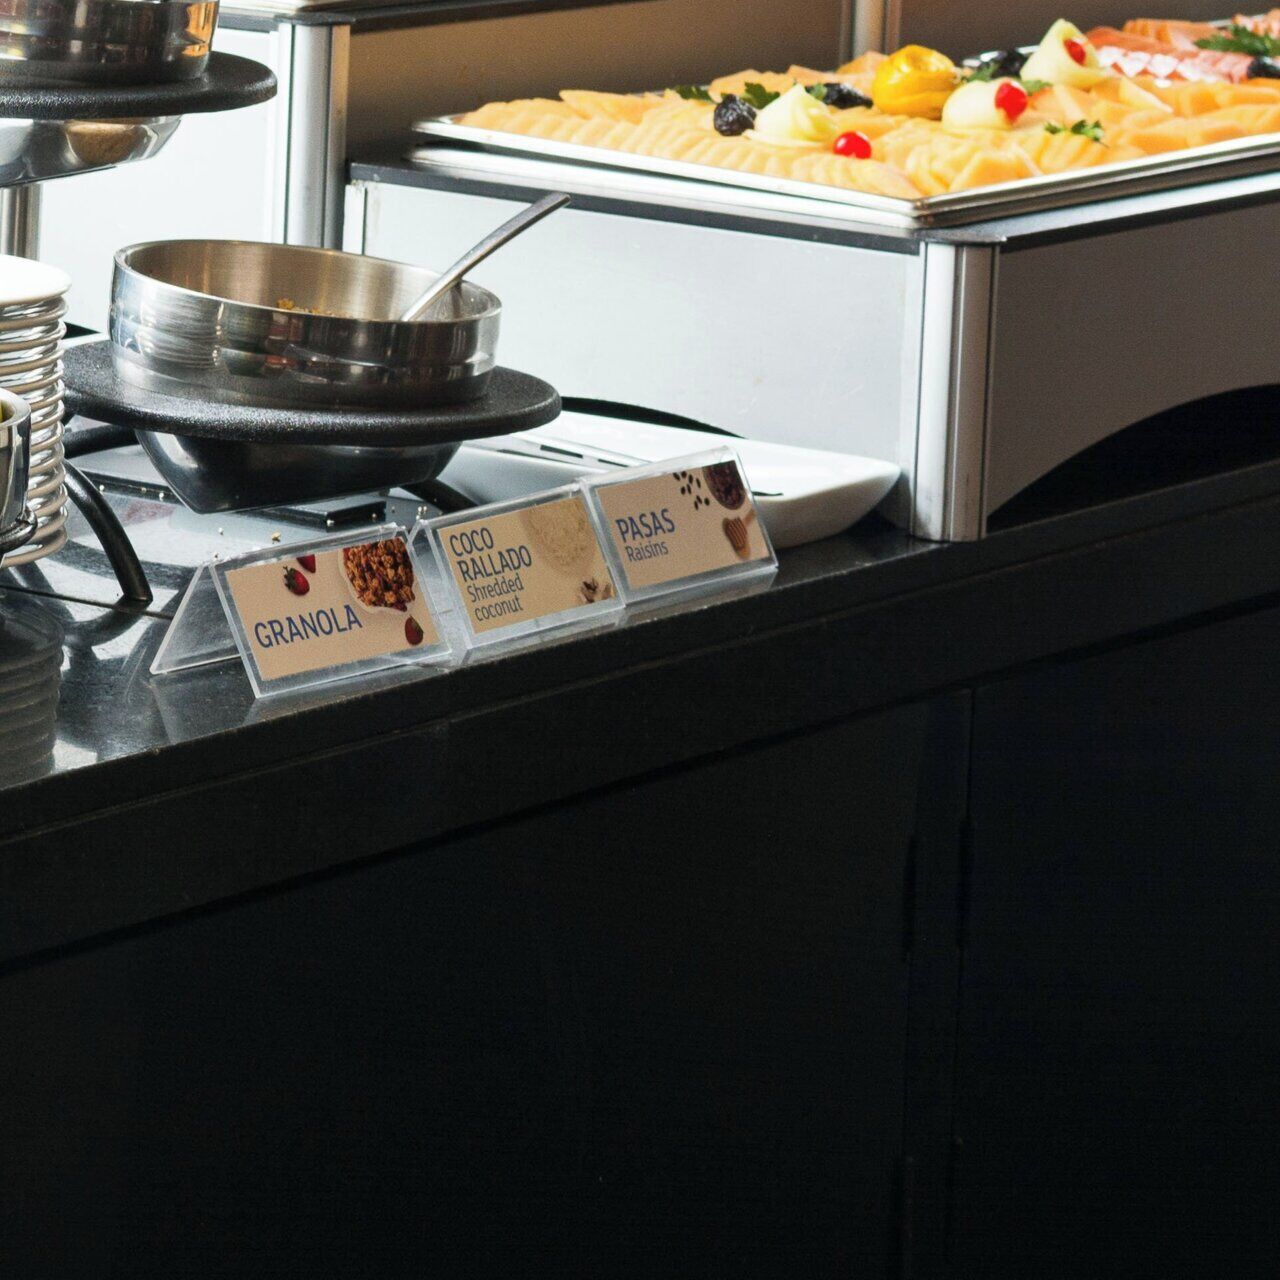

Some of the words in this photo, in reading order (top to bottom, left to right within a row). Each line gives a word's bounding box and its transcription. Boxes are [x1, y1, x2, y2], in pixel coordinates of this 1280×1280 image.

[615, 508, 675, 543] PASAS
[449, 527, 494, 557] COCO
[625, 541, 669, 562] Raisins
[457, 545, 532, 582] RALLADO
[467, 572, 524, 603] Shredded
[474, 595, 524, 621] coconut
[254, 604, 363, 648] GRANOLA
